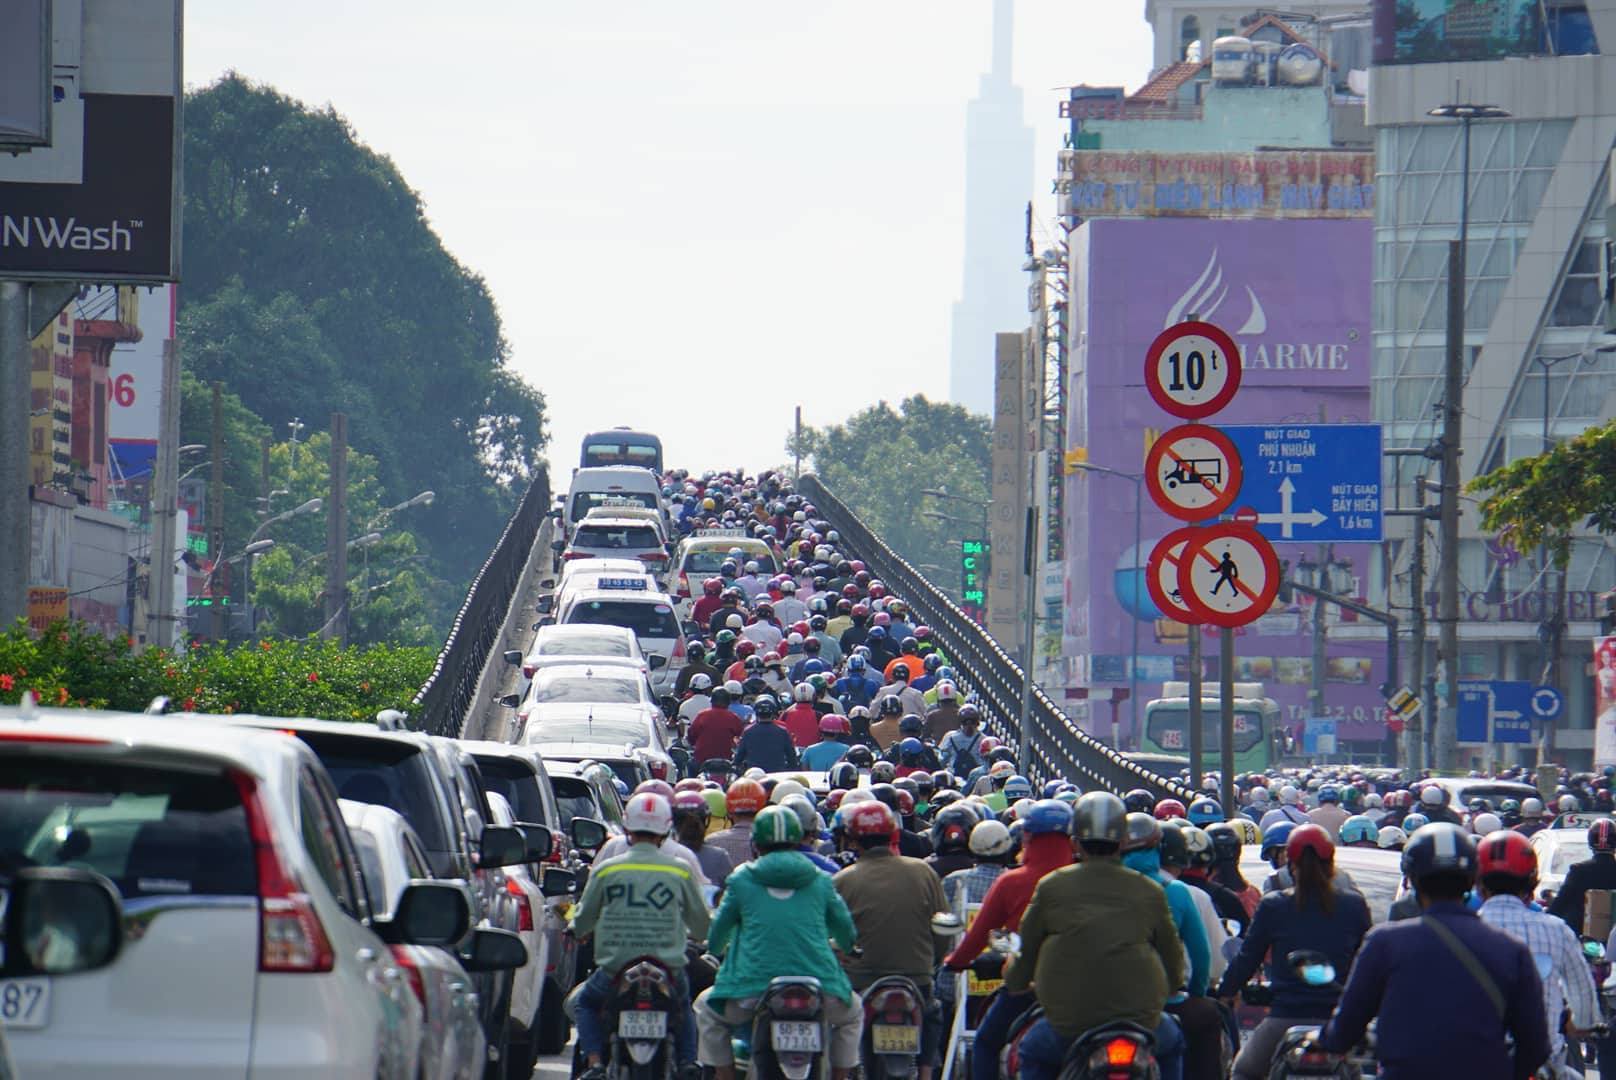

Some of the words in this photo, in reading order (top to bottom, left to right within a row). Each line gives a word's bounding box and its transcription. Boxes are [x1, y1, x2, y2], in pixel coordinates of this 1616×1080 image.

[1168, 351, 1206, 391] 10
[1259, 440, 1280, 457] PHÚ
[1286, 460, 1303, 473] km
[1356, 515, 1374, 529] km
